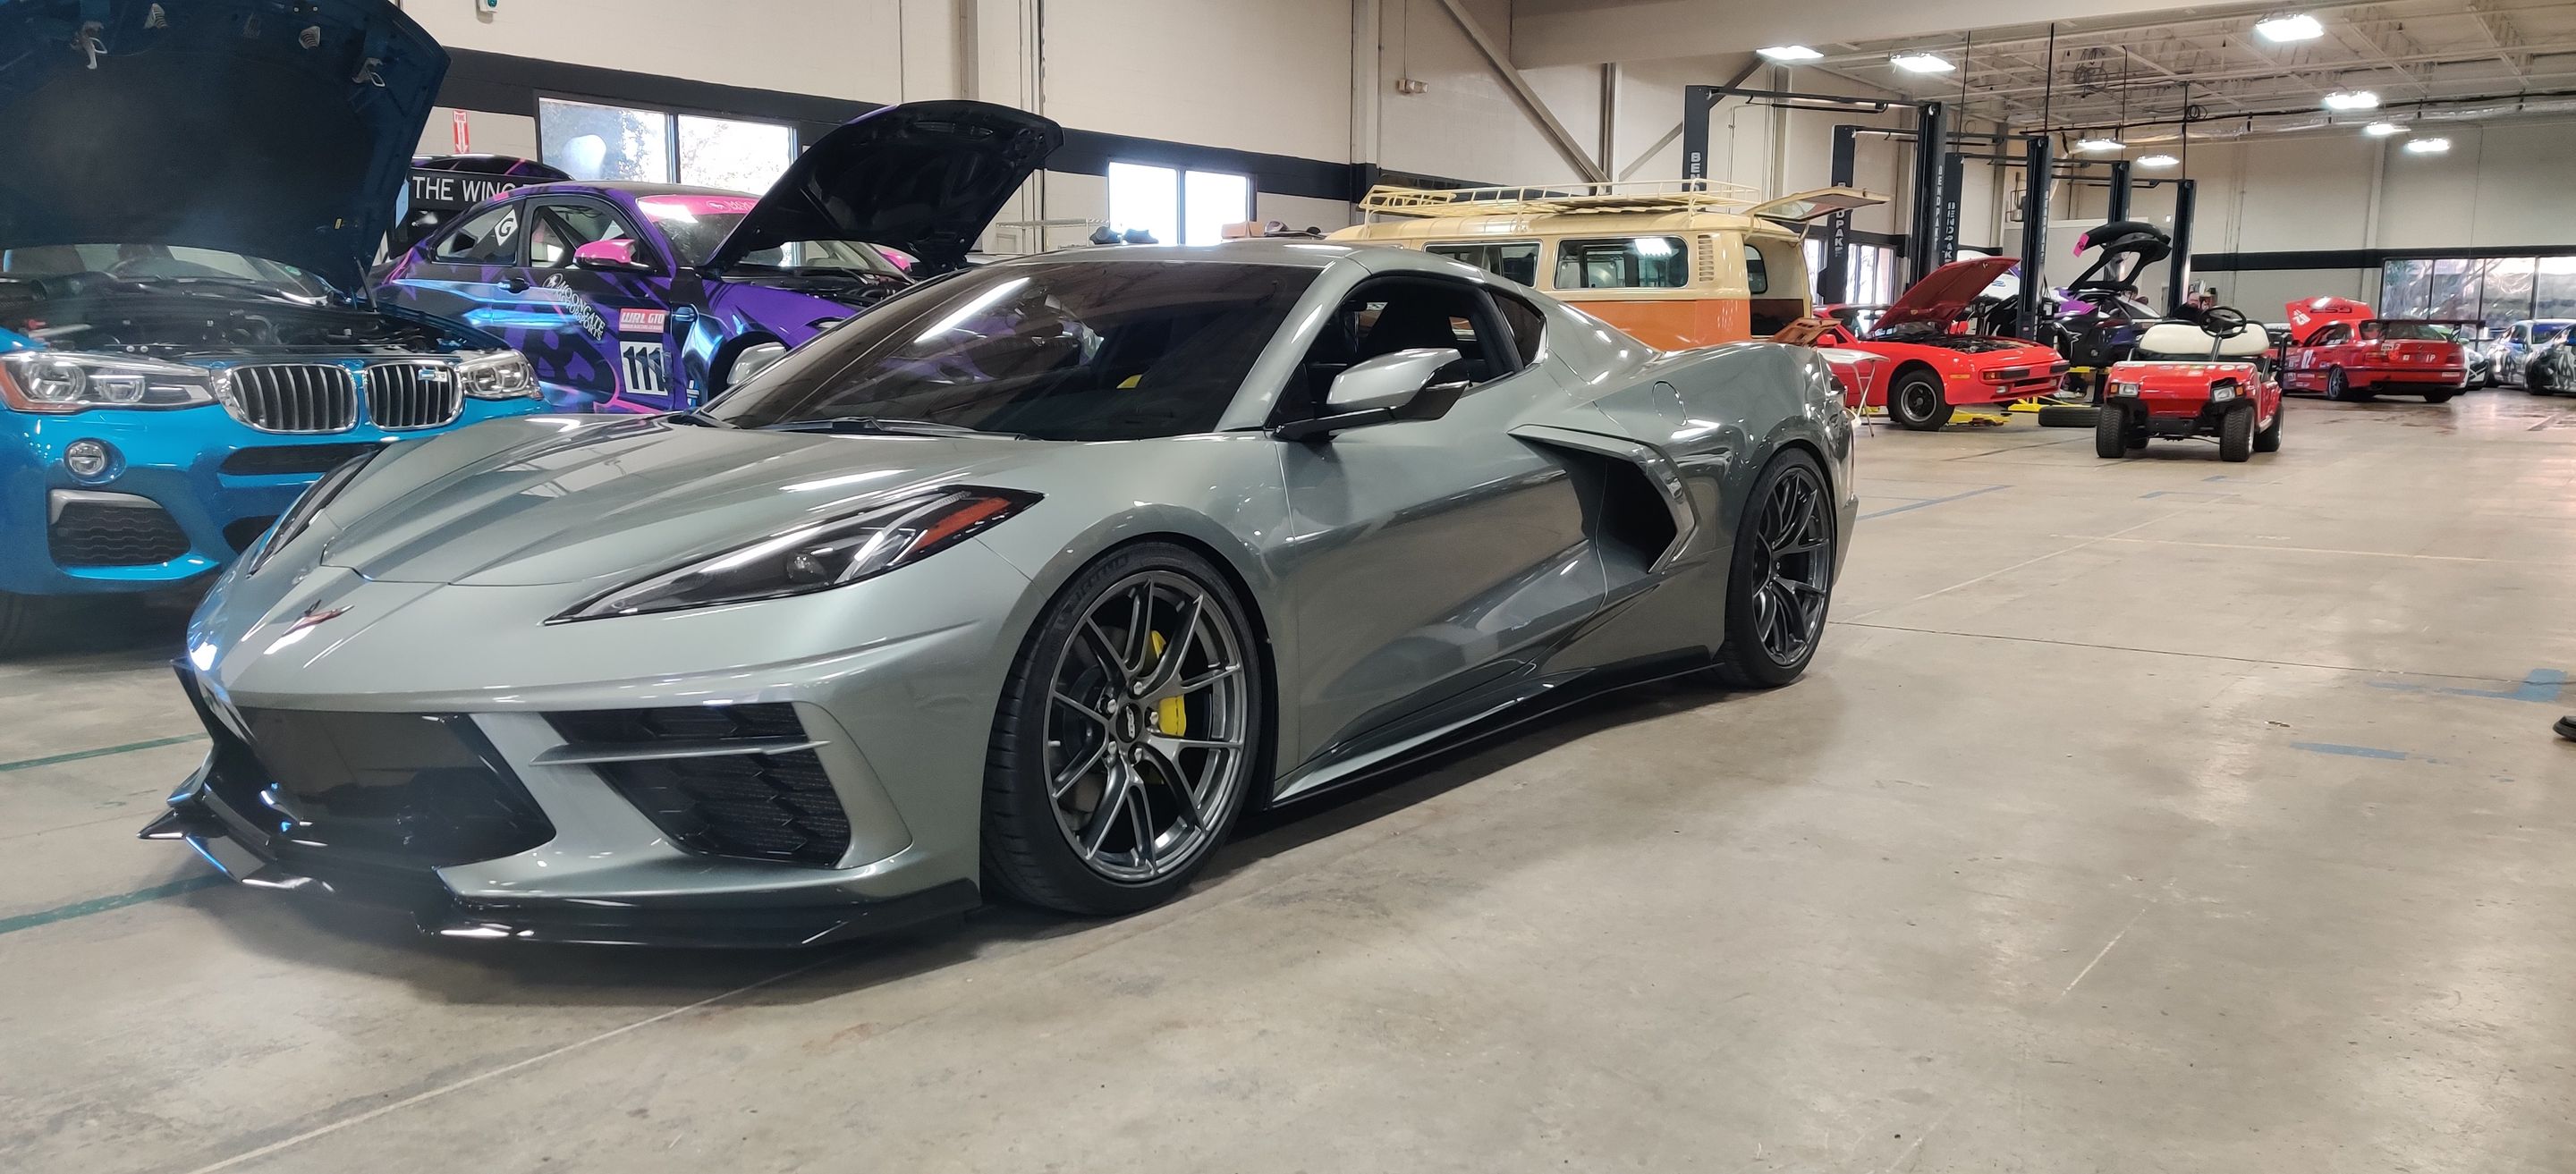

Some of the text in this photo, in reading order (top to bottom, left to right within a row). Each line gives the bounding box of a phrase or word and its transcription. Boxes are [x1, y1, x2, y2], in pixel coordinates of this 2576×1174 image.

[412, 176, 454, 201] THE
[499, 218, 514, 237] G
[556, 280, 606, 333] MOONGATE
[623, 346, 665, 392] 111
